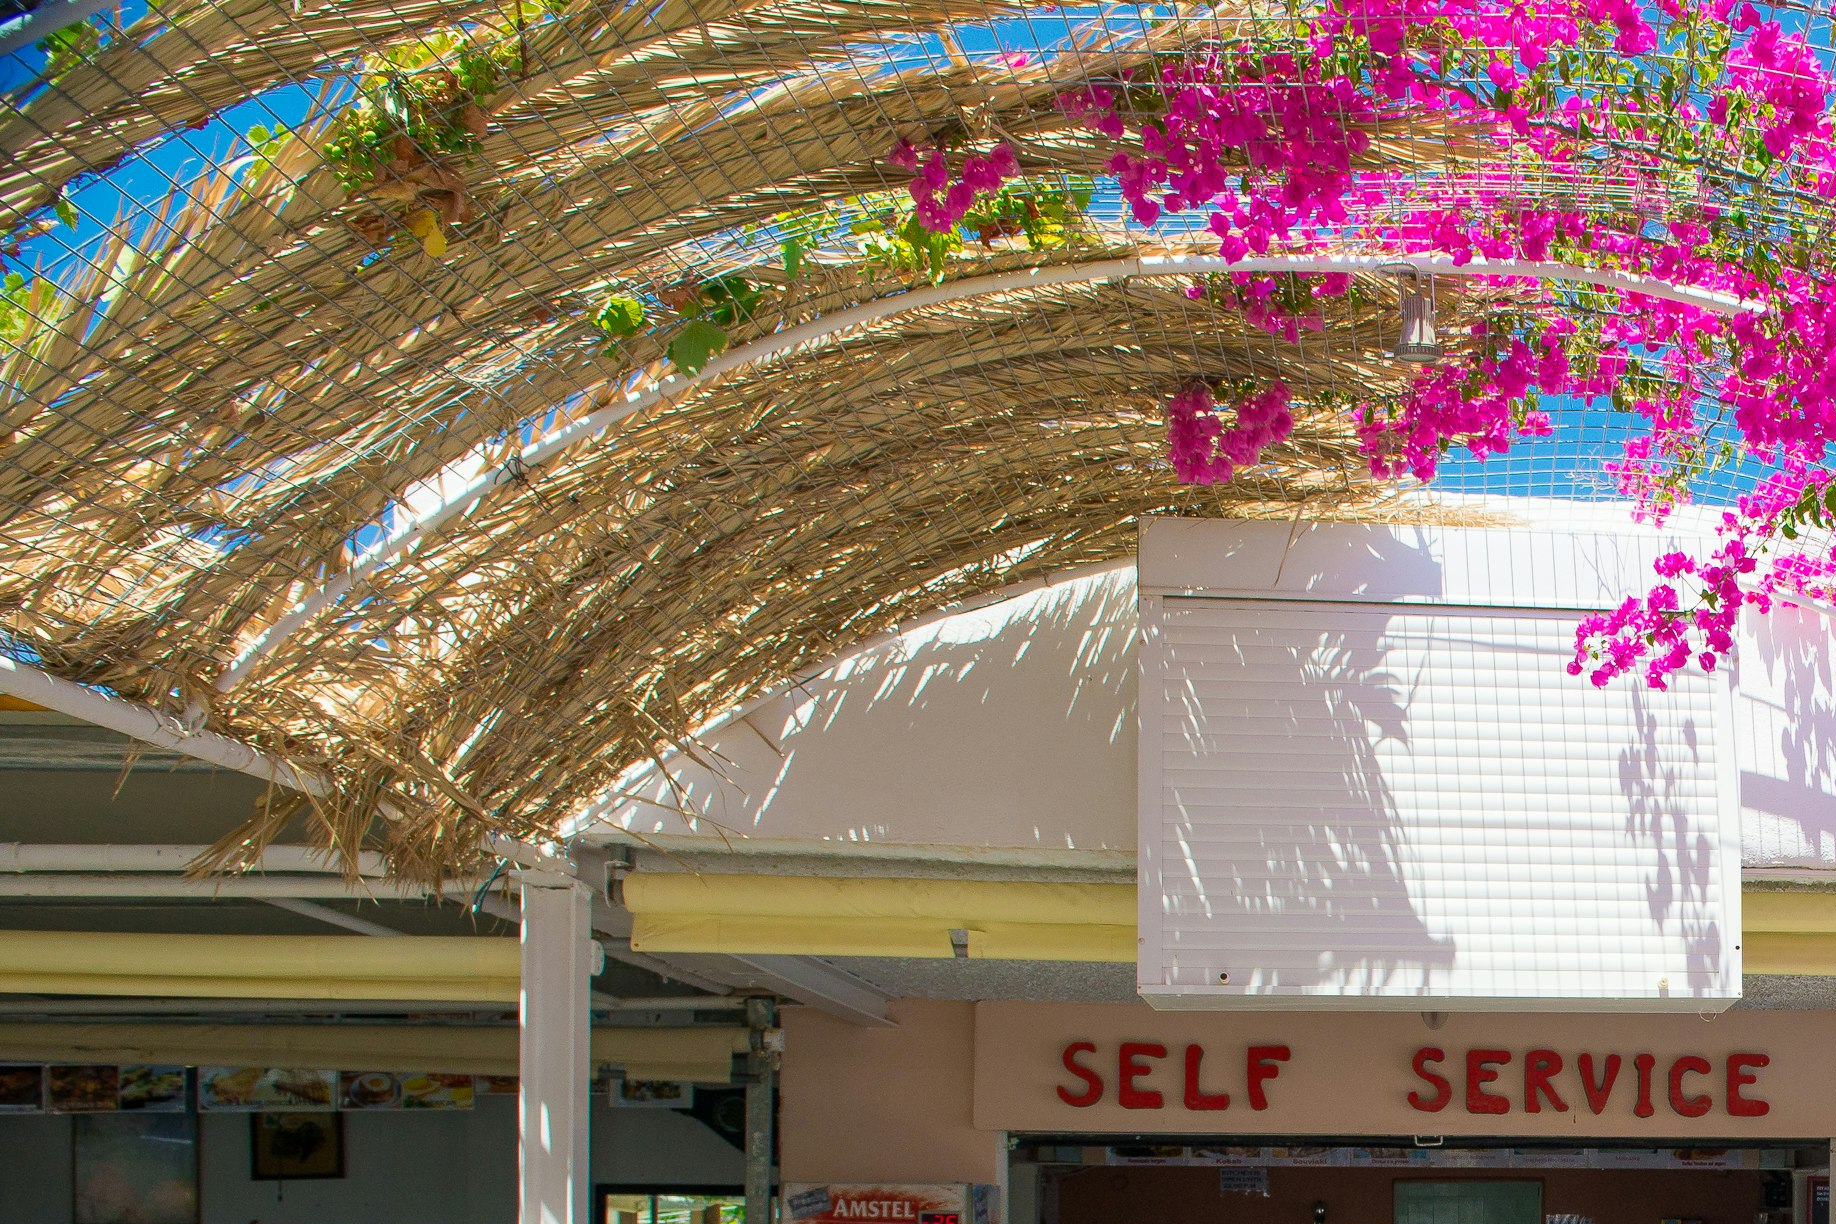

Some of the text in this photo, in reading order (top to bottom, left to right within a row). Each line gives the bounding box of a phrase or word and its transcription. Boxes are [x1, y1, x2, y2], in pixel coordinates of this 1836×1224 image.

[1056, 1041, 1771, 1119] SELF SERVICE
[833, 1198, 915, 1218] AMSTEL
